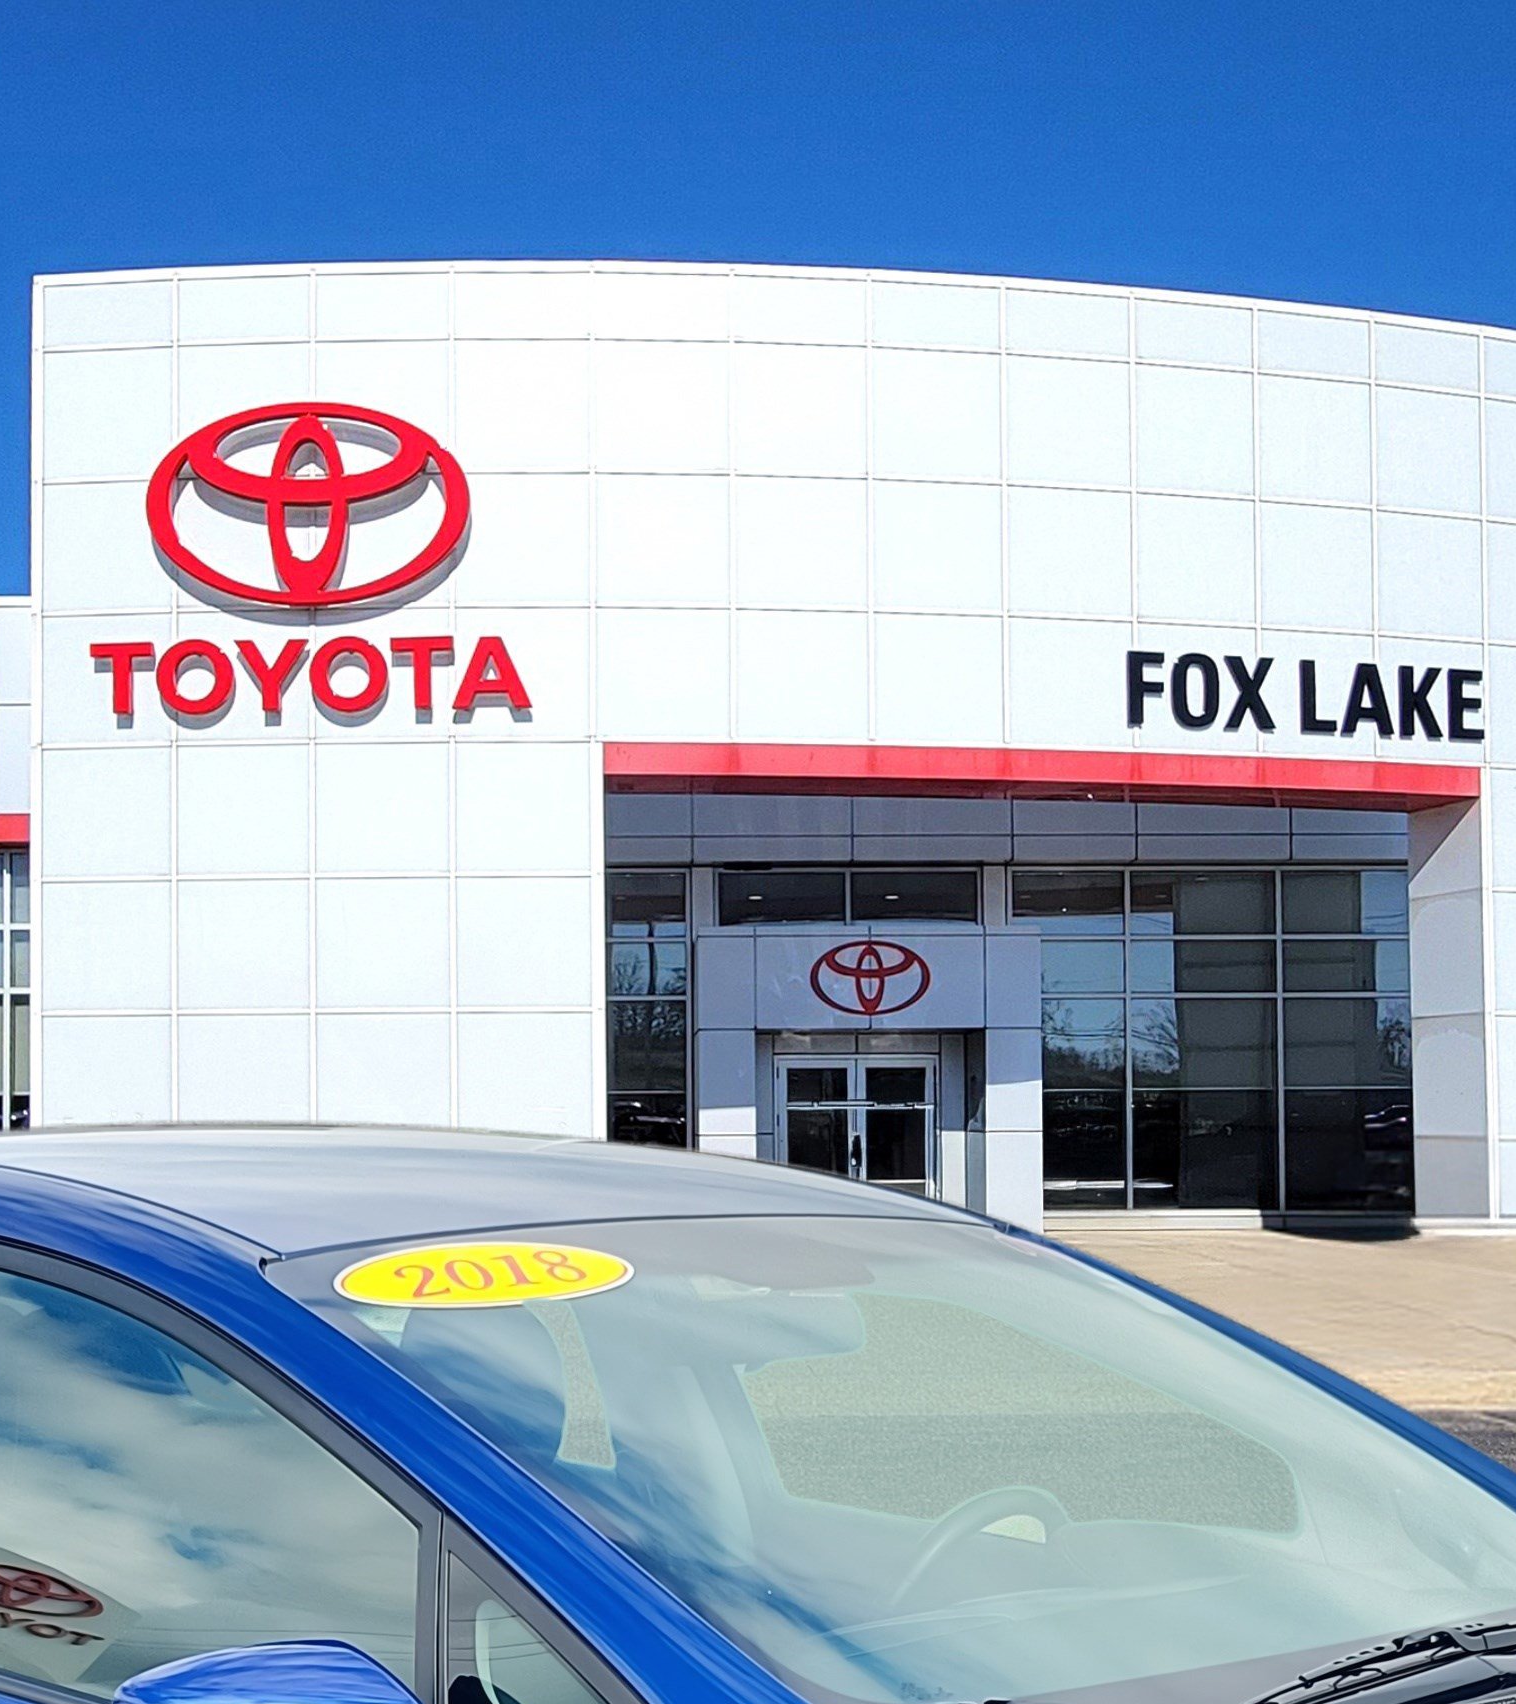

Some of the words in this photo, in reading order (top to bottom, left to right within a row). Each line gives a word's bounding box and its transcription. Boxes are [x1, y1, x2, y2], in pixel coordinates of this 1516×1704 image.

[89, 635, 534, 718] TOYOTA
[1126, 650, 1277, 733] FOX
[1298, 659, 1486, 742] LAKE
[393, 1250, 587, 1299] 2018
